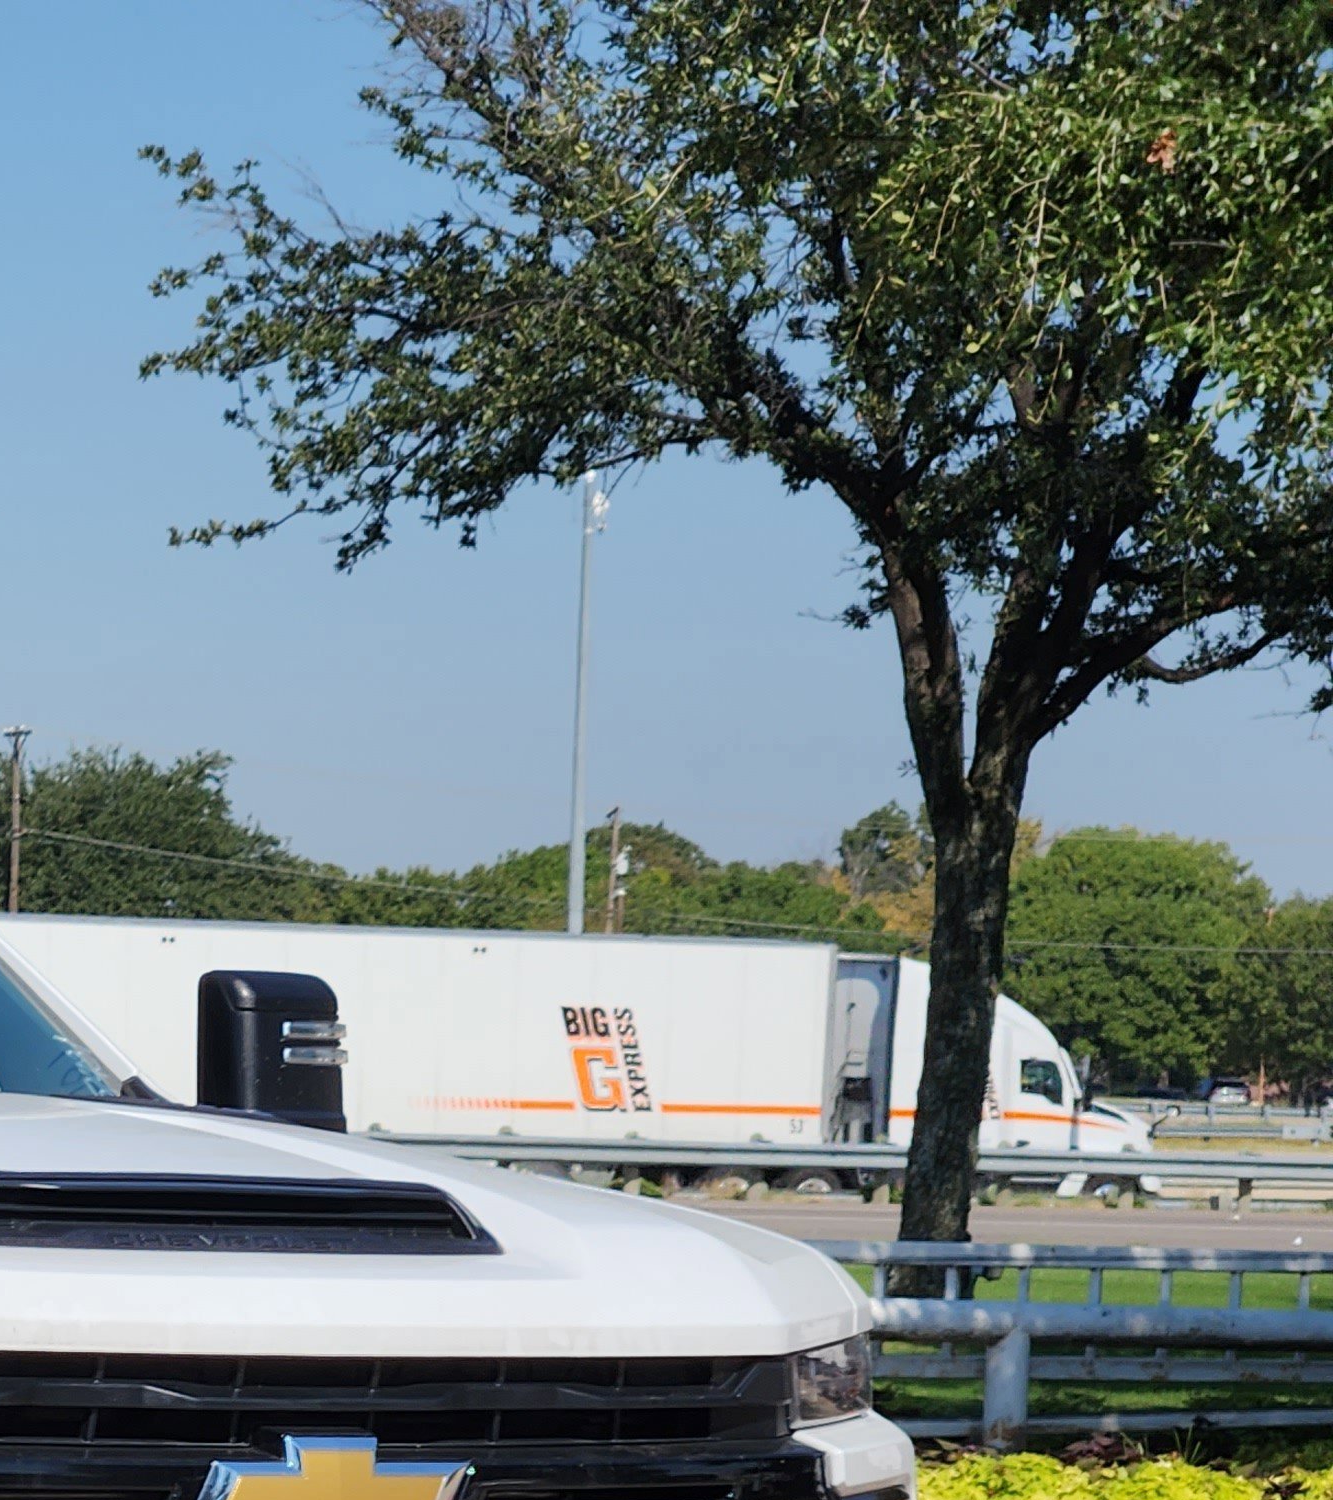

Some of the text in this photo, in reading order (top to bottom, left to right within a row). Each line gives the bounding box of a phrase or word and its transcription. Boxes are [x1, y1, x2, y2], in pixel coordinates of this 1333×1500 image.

[561, 1006, 610, 1037] BIG
[572, 1048, 627, 1112] G
[614, 1008, 652, 1112] EXPRESS
